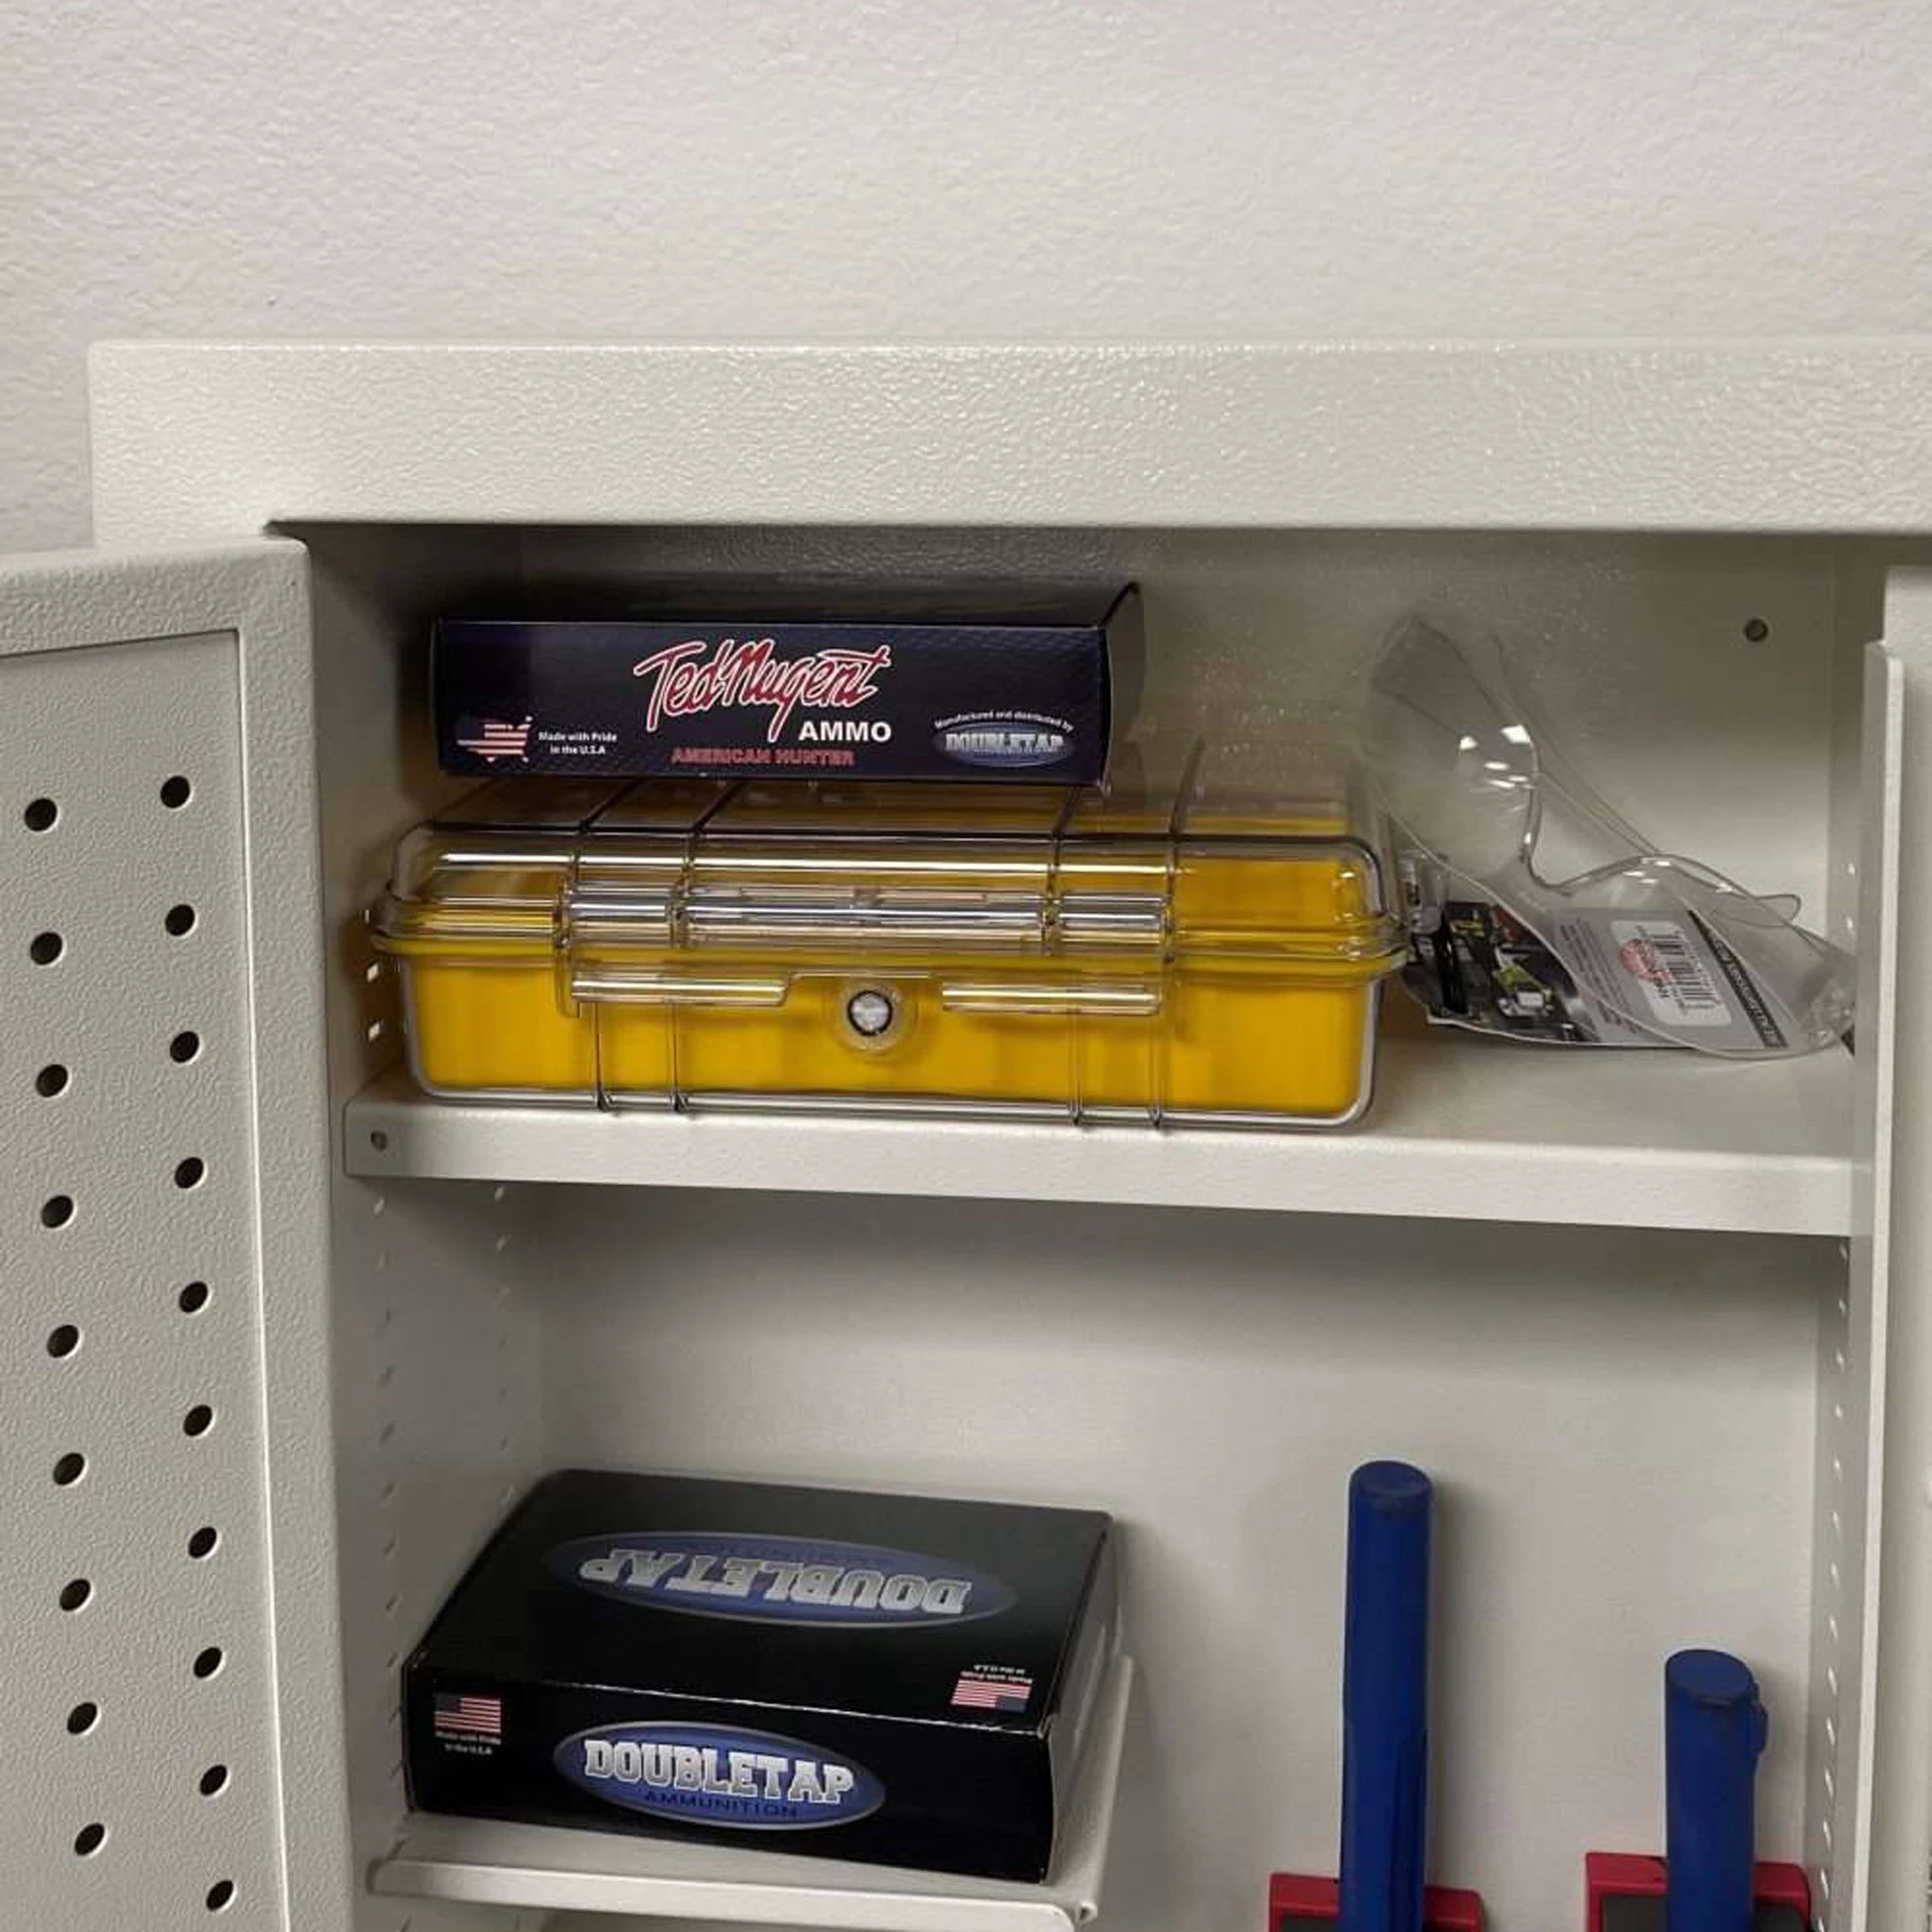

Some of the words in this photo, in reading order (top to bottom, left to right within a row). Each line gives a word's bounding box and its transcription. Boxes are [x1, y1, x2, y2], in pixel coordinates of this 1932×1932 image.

[633, 639, 733, 732] Ted
[722, 639, 892, 743] Nugent
[798, 721, 893, 743] AMMO
[945, 731, 1064, 753] DOUBLETAP
[670, 747, 772, 765] AMERICAN
[775, 748, 855, 766] HUNTER
[579, 1548, 973, 1615] DOUBLETAP
[584, 1739, 854, 1804] DOUBLETAP
[643, 1792, 798, 1818] AMMUNITION
